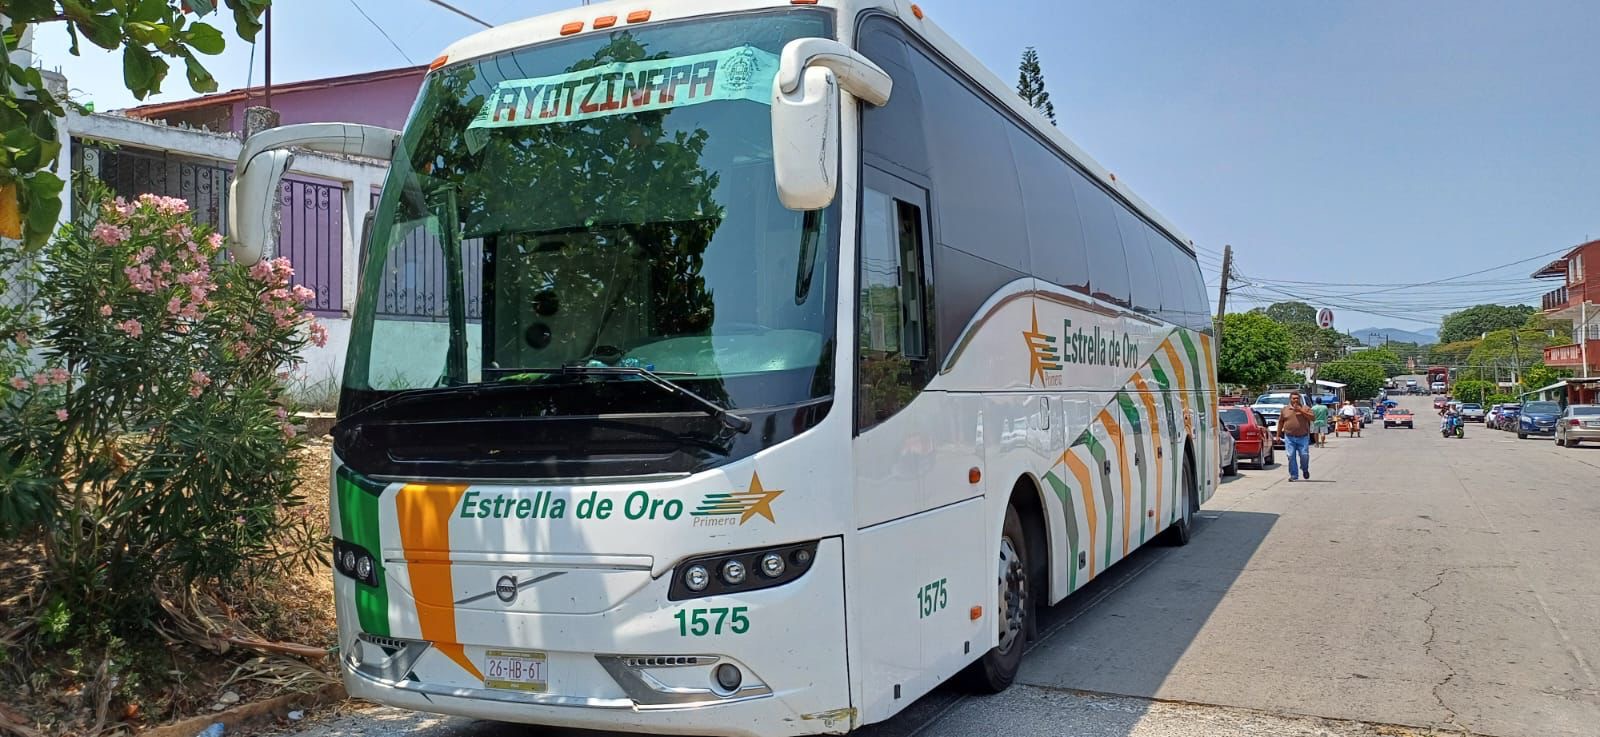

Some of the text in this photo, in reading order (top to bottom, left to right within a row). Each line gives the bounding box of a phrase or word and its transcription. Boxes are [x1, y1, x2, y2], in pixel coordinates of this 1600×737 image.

[493, 60, 718, 122] AYOTZINAPA
[1064, 319, 1138, 369] Estrella de Oro
[460, 491, 684, 521] Estrella de Oro
[692, 516, 736, 528] Primera
[916, 578, 948, 619] 1575
[674, 606, 750, 637] 1575
[490, 660, 541, 680] 26-HB-6T
